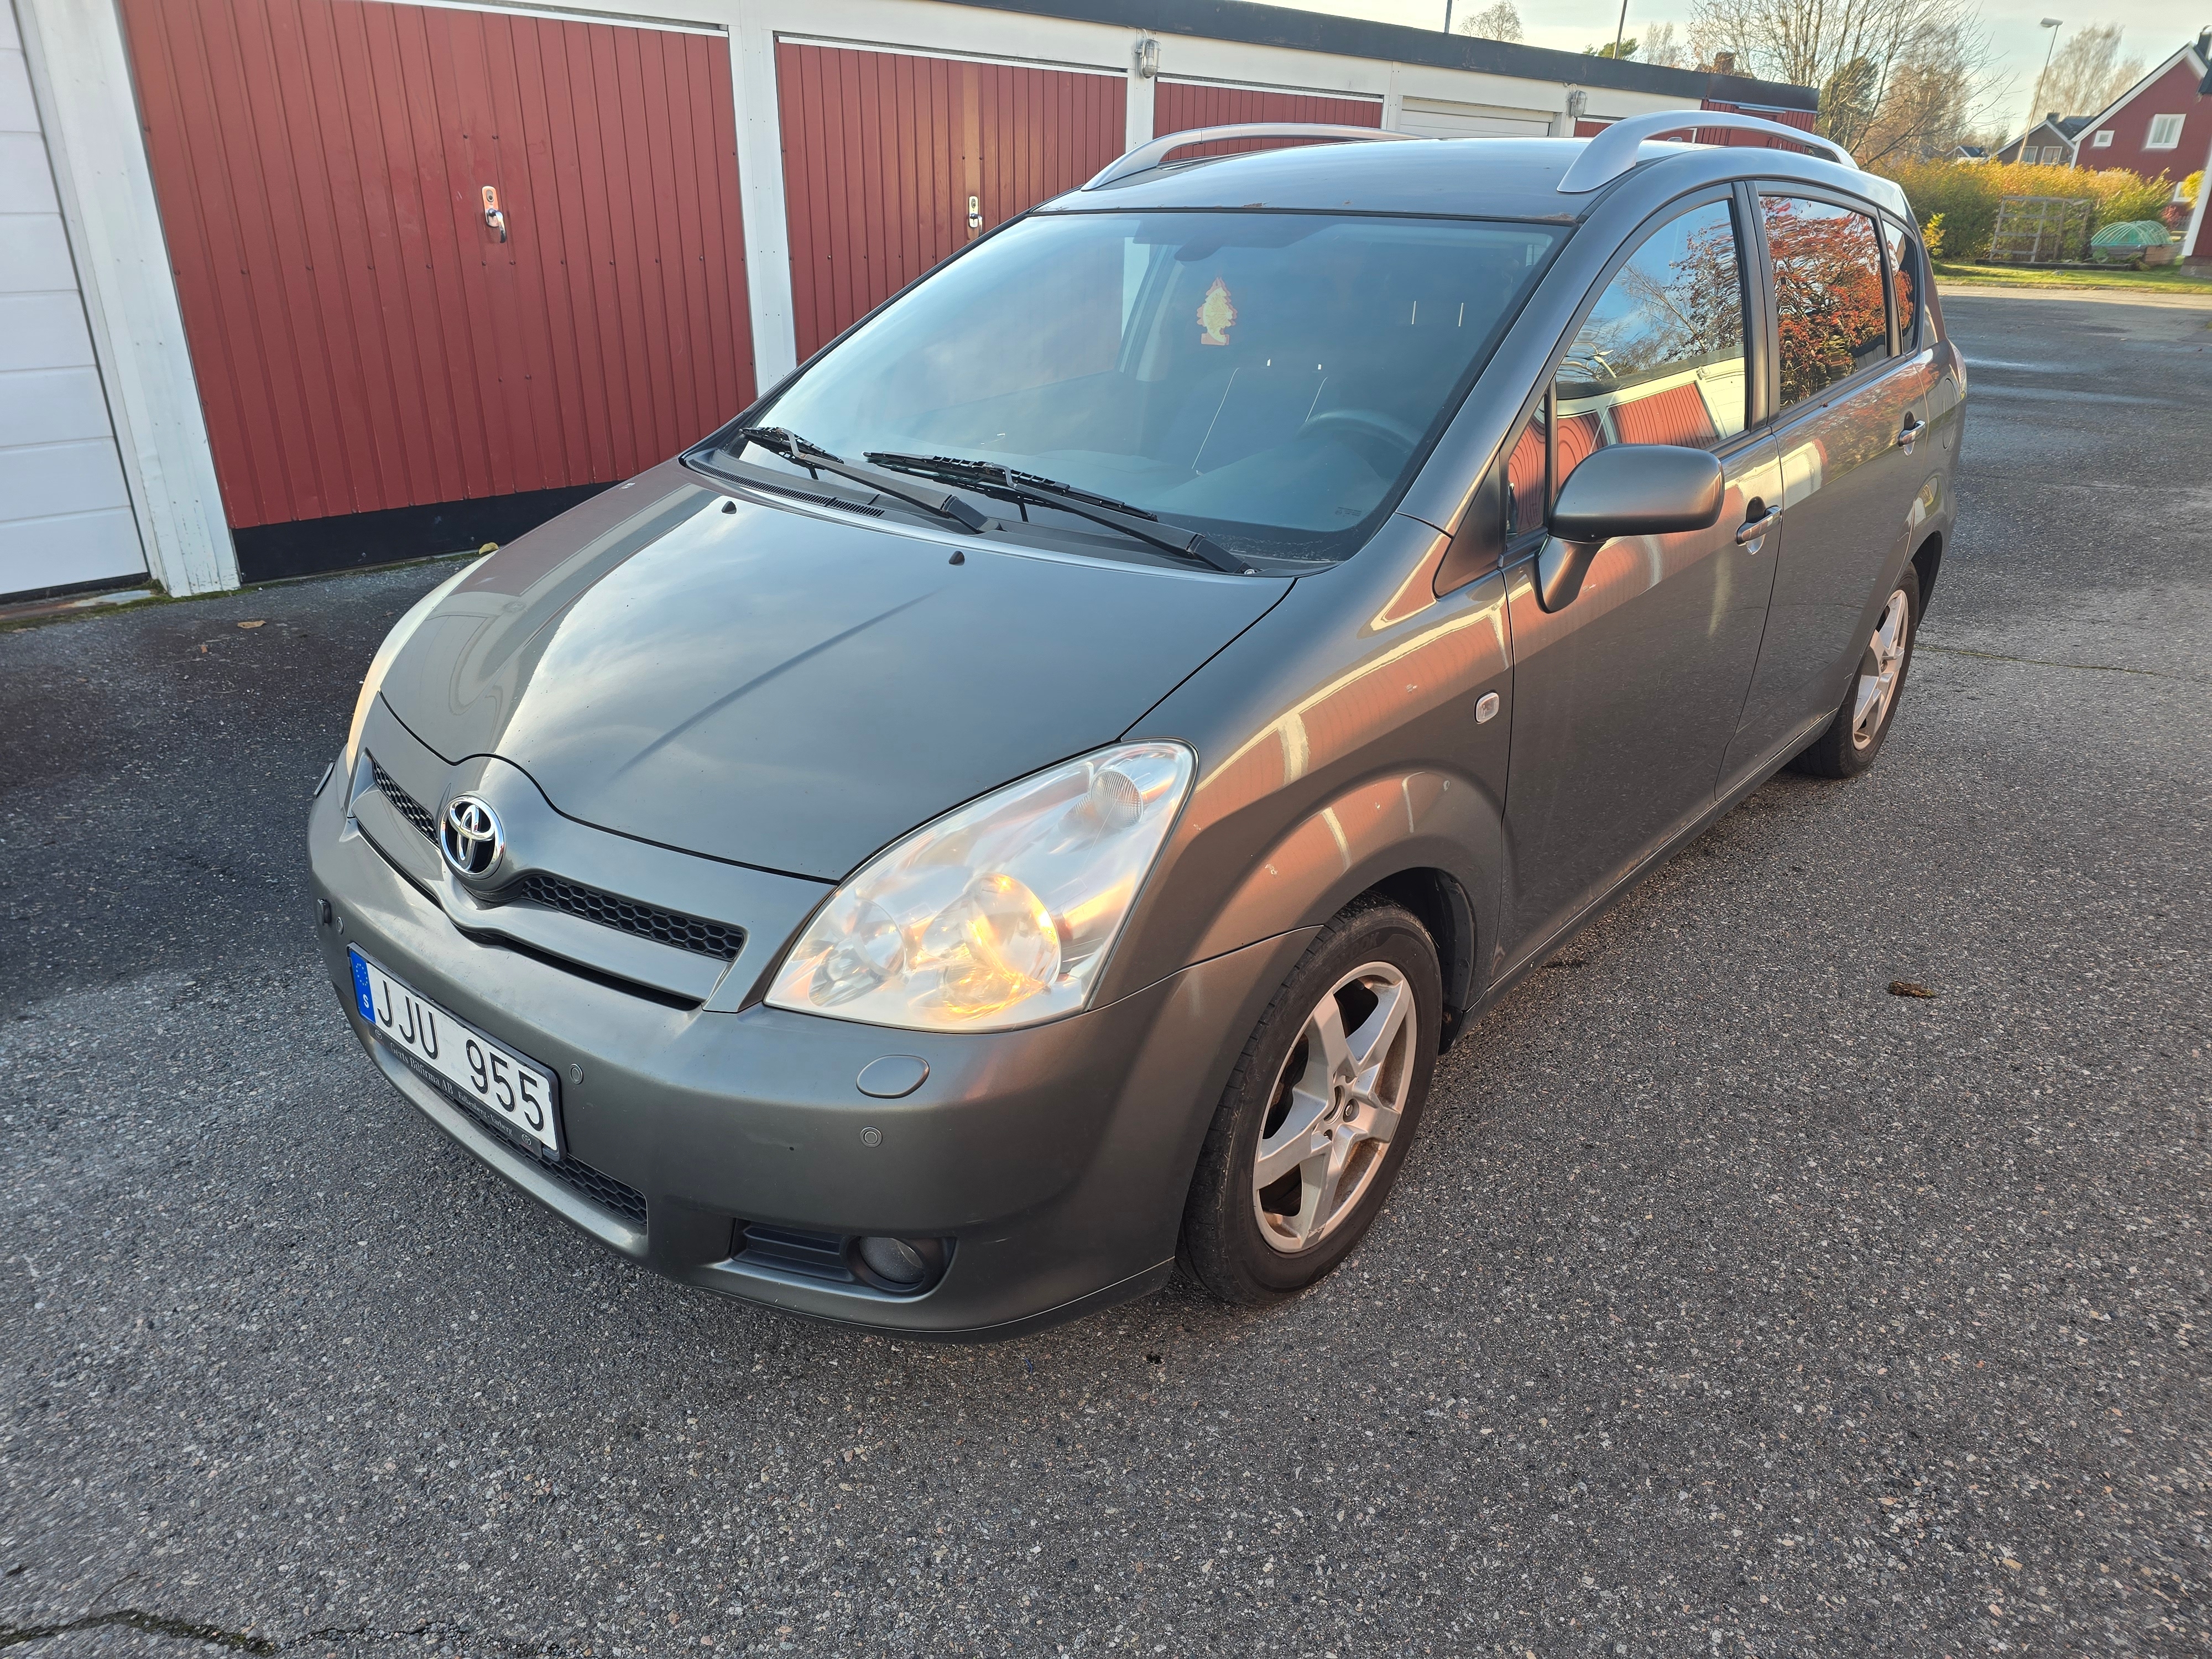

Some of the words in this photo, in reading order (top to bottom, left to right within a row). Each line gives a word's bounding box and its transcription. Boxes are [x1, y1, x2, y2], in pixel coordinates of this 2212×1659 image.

[363, 994, 369, 1009] S
[377, 979, 439, 1060] JJU
[466, 1039, 544, 1132] 955
[390, 1042, 409, 1064] Gerts
[409, 1056, 440, 1086] Bilfirma
[442, 1079, 453, 1094] AB
[458, 1091, 487, 1119] Falkenberg
[490, 1114, 513, 1136] Varberg
